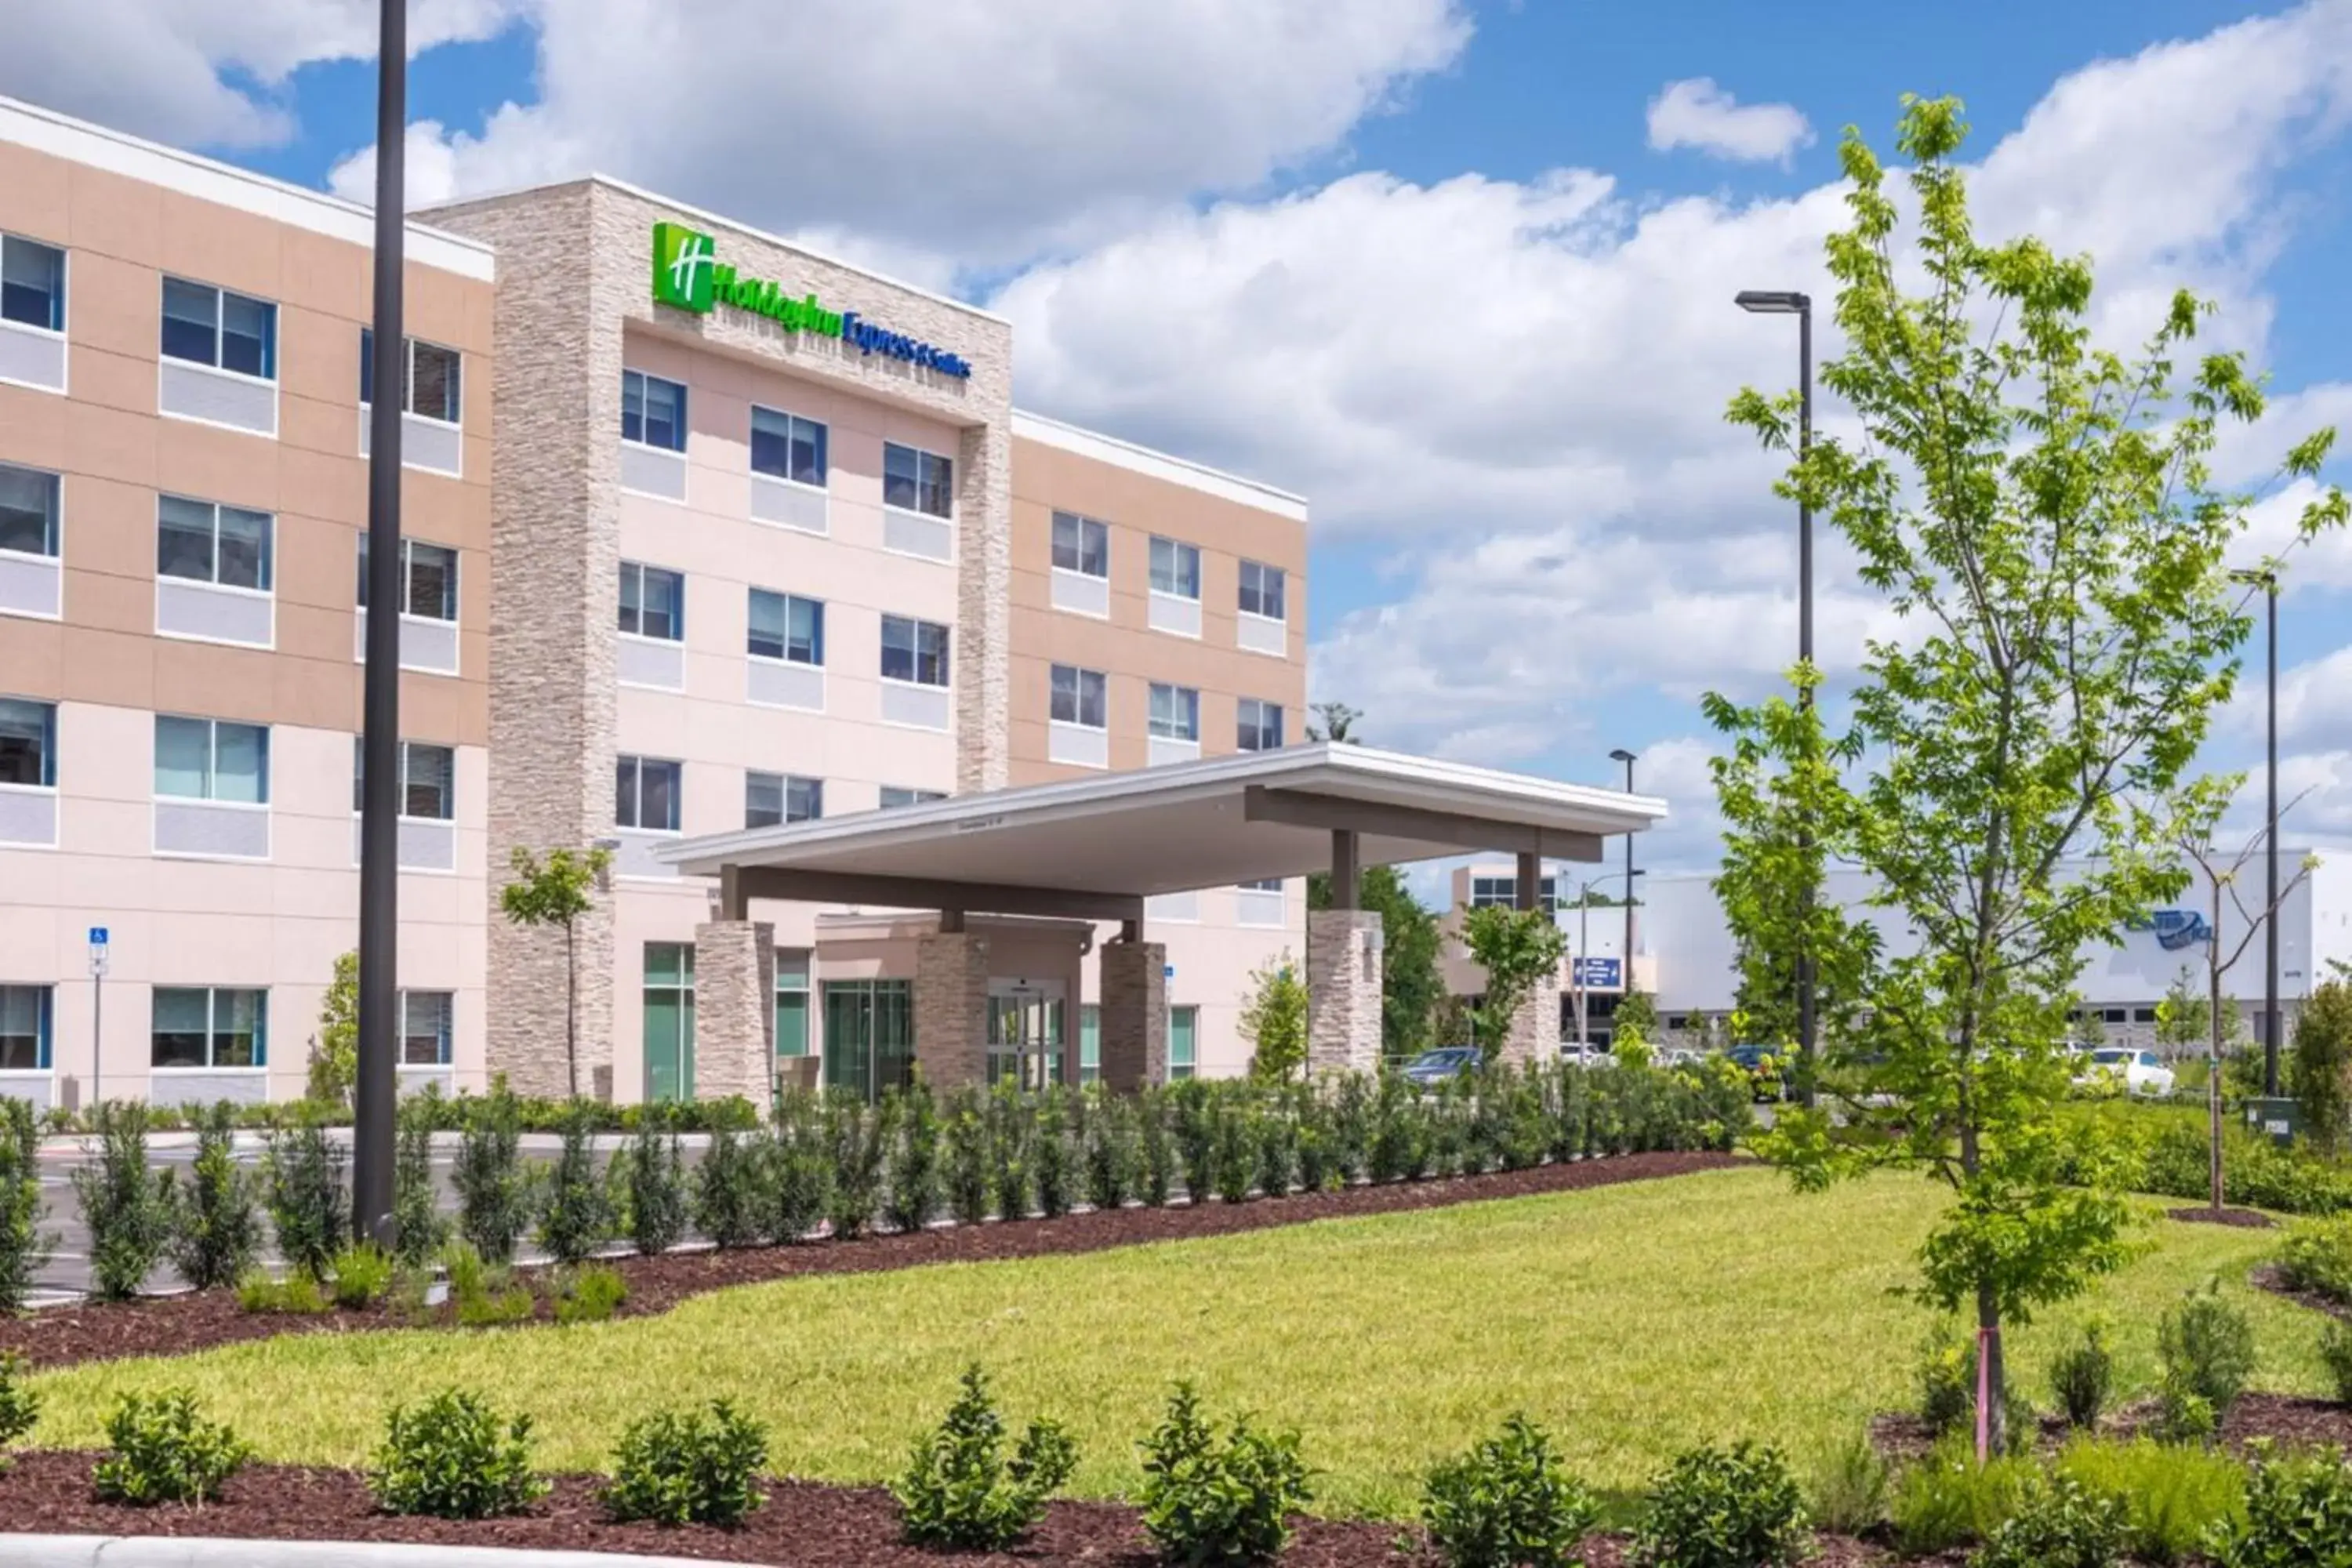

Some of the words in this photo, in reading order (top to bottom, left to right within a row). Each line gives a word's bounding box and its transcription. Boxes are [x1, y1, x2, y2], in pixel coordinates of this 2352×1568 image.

[713, 263, 804, 333] Holiday
[804, 293, 844, 338] Inn
[843, 312, 917, 362] Express
[927, 348, 971, 379] Suites
